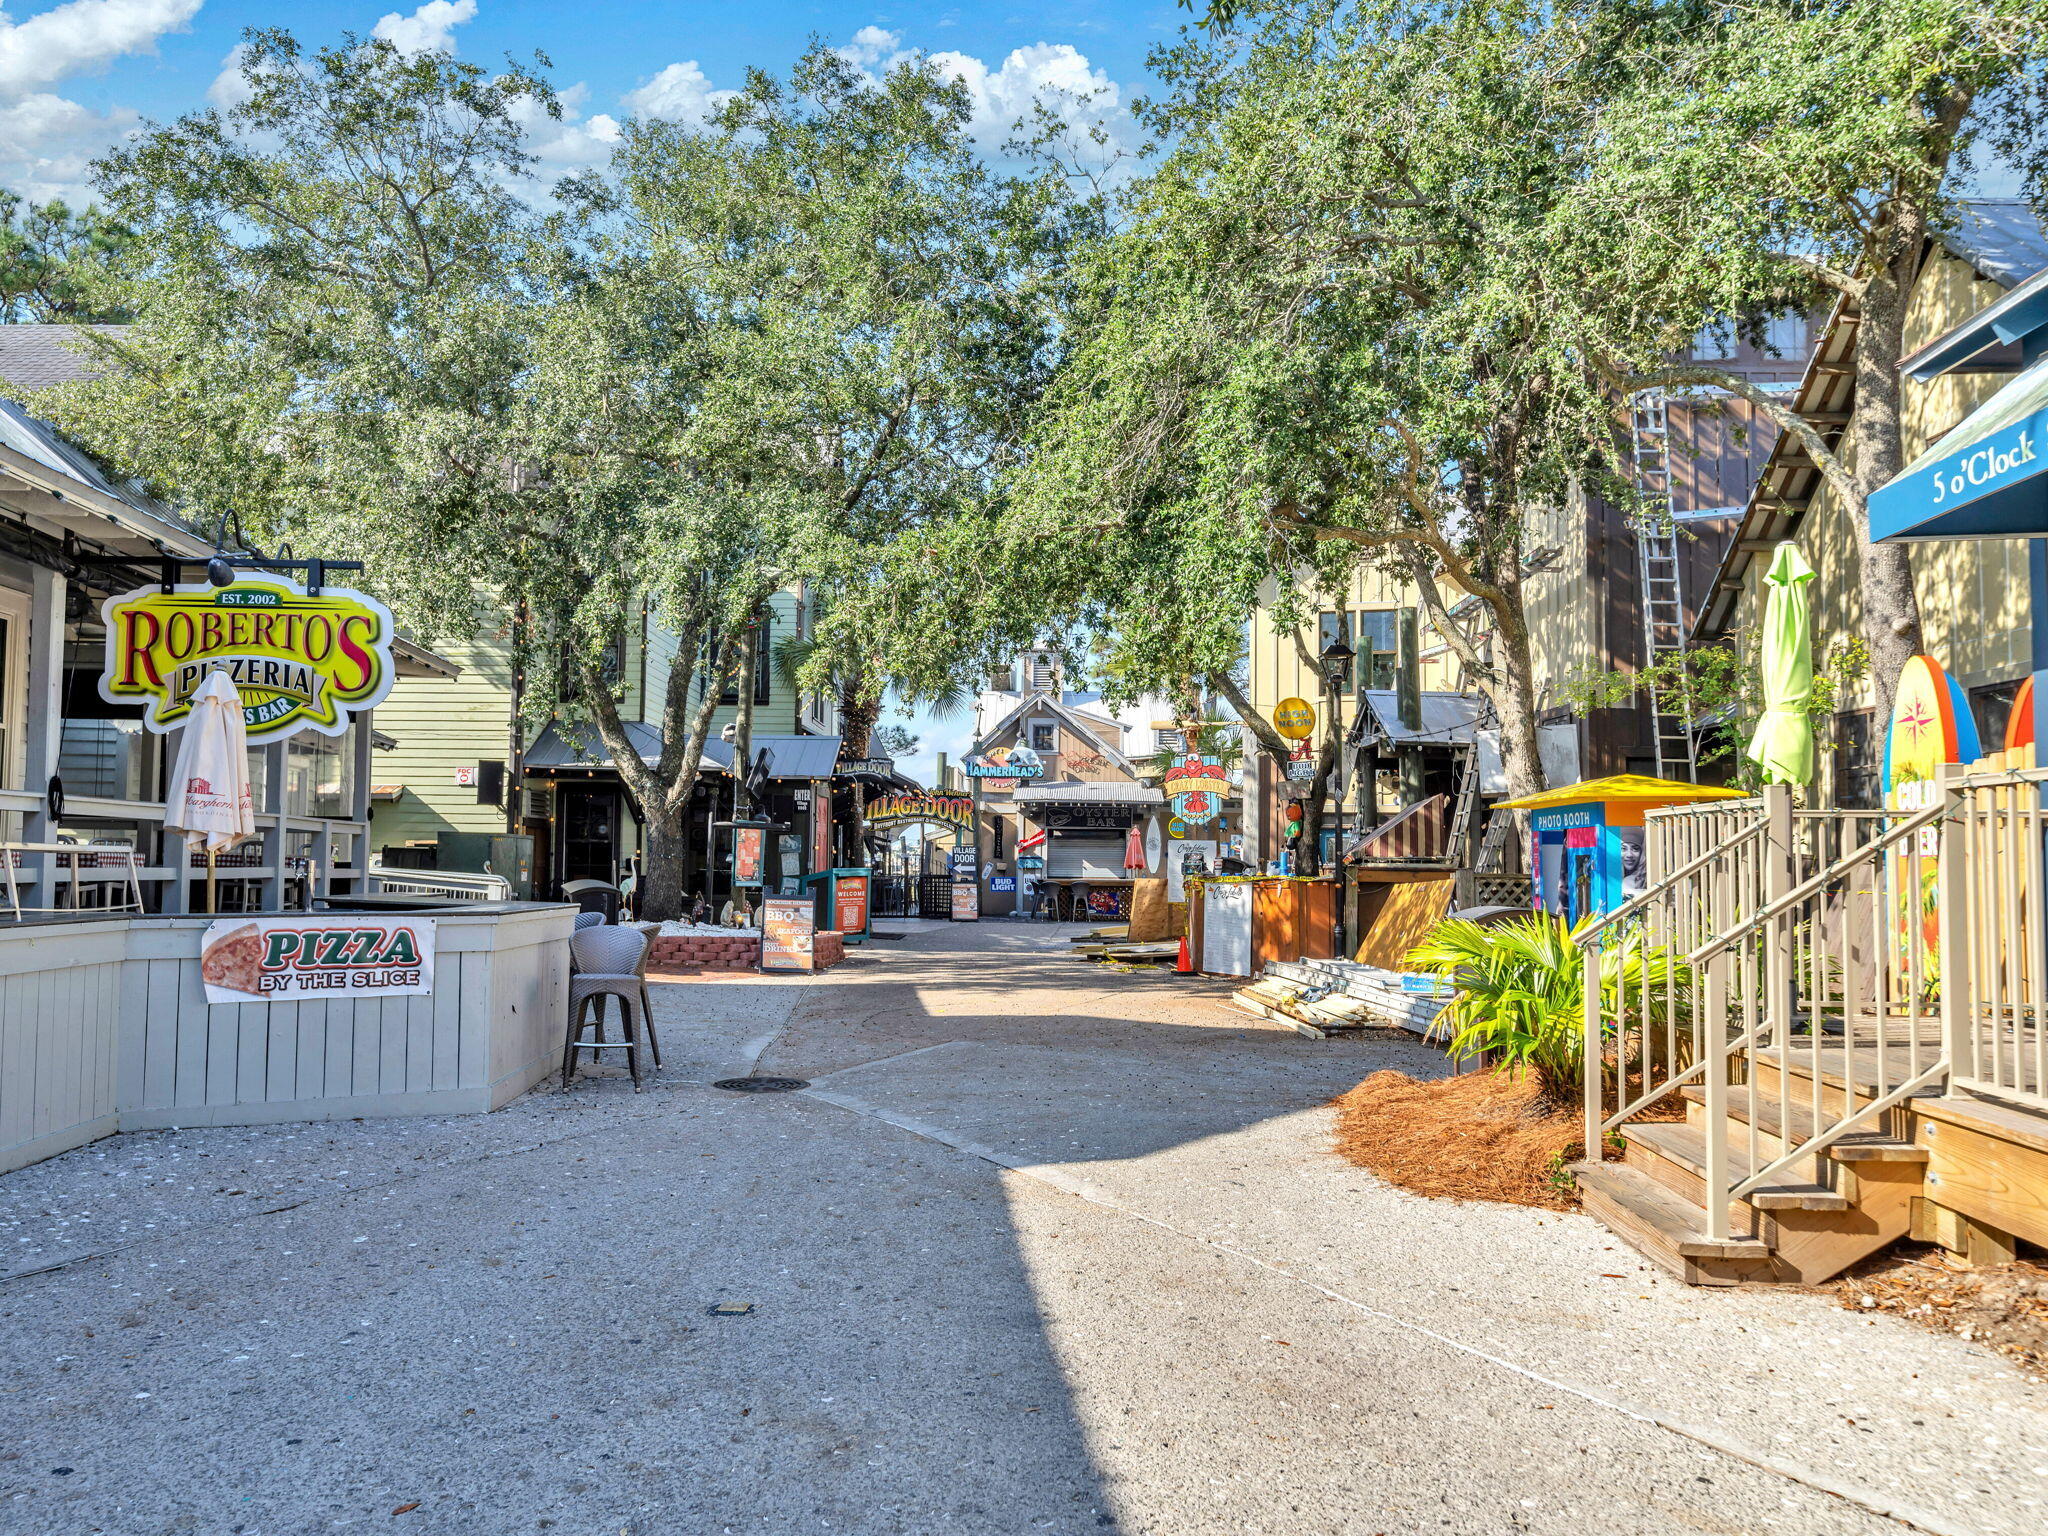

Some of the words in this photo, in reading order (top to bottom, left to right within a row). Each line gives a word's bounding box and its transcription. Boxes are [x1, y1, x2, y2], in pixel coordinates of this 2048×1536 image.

[1933, 471, 1945, 503] 5
[1950, 431, 2036, 494] o'Clock
[222, 593, 244, 604] EST.
[247, 594, 276, 605] 2002
[118, 611, 372, 692] ROBERTO'S
[181, 658, 311, 695] PIZERIA
[259, 697, 292, 723] BAR
[1279, 710, 1308, 719] HIGH
[1278, 719, 1311, 727] NOON
[794, 789, 811, 800] ENTER
[1897, 779, 1936, 810] COLD
[866, 796, 921, 819] ILLAGE
[923, 797, 975, 831] DOOR
[1073, 808, 1130, 817] OYSTER
[1538, 814, 1562, 828] PHOTO
[1564, 812, 1590, 827] BOOTH
[1087, 818, 1116, 827] BAR
[954, 854, 975, 863] DOOR
[765, 911, 795, 923] BBQ
[260, 928, 421, 970] PIZZA
[259, 974, 292, 991] BY
[297, 973, 346, 990] THE
[352, 970, 420, 987] SLICE
